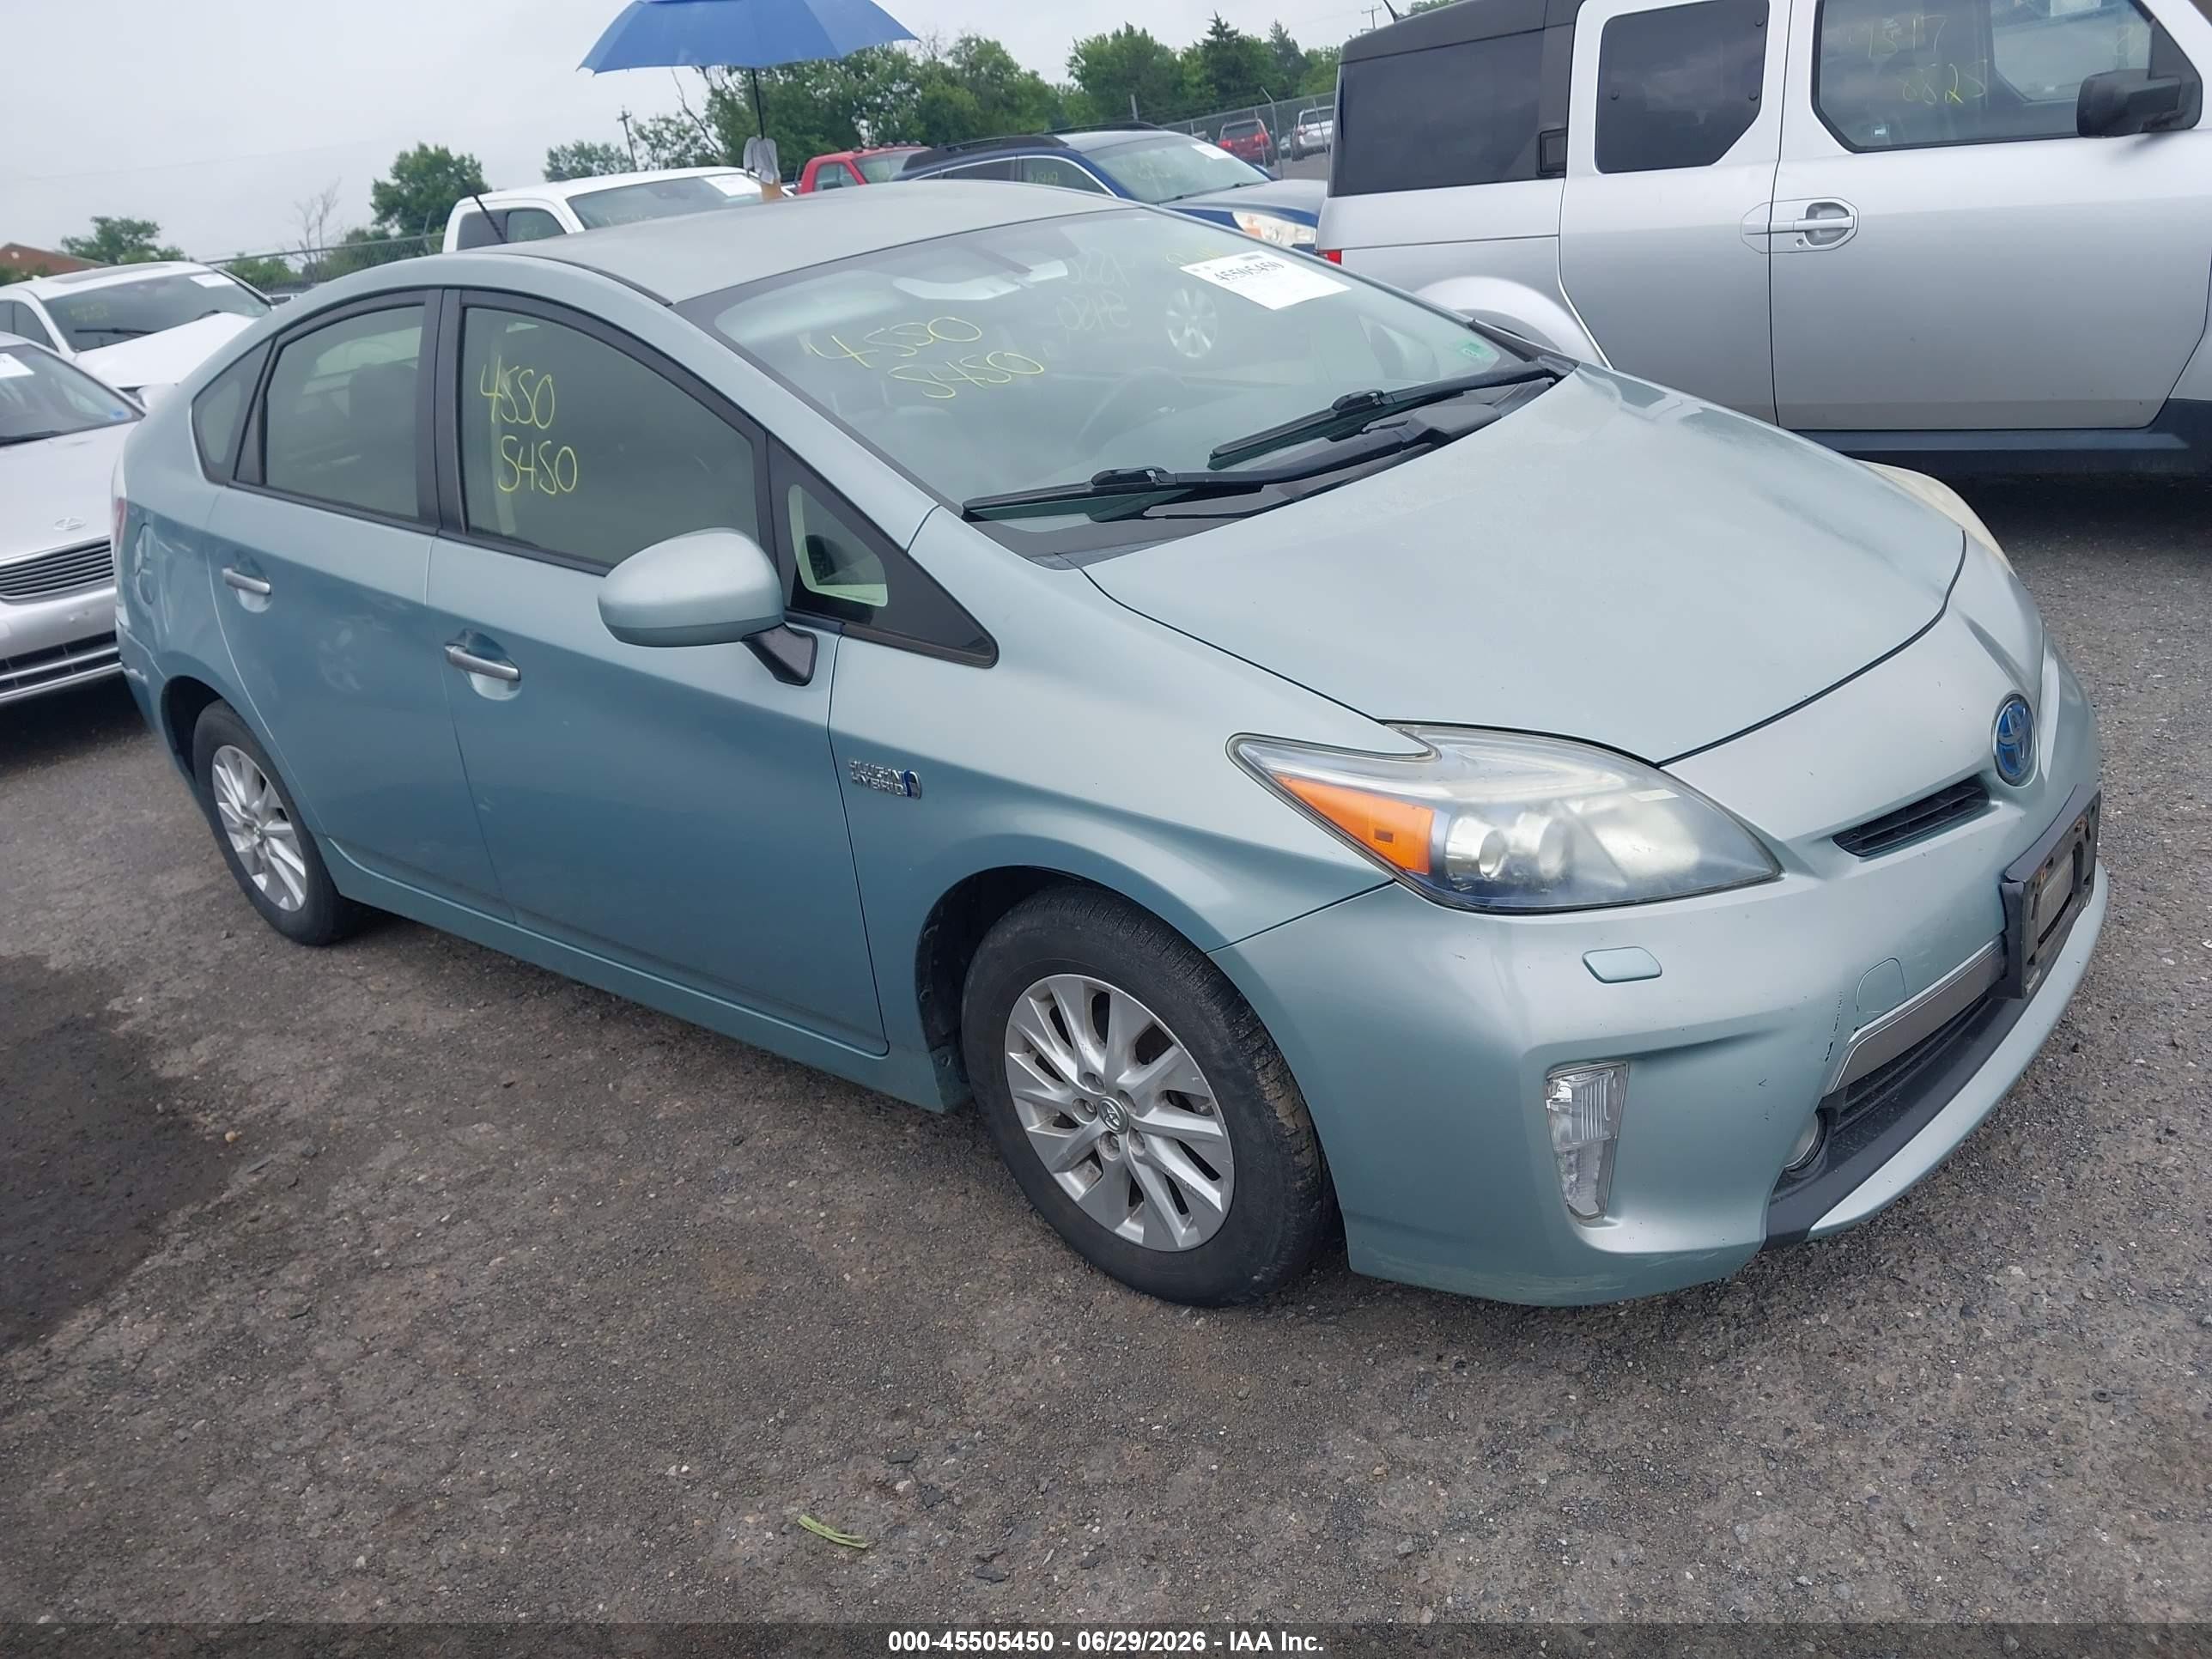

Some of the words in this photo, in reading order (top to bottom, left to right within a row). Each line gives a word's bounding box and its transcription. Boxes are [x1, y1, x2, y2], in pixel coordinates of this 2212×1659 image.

[807, 316, 982, 368] 4550
[479, 355, 556, 429] 4550
[887, 350, 1044, 398] 5450
[497, 434, 578, 495] 5450
